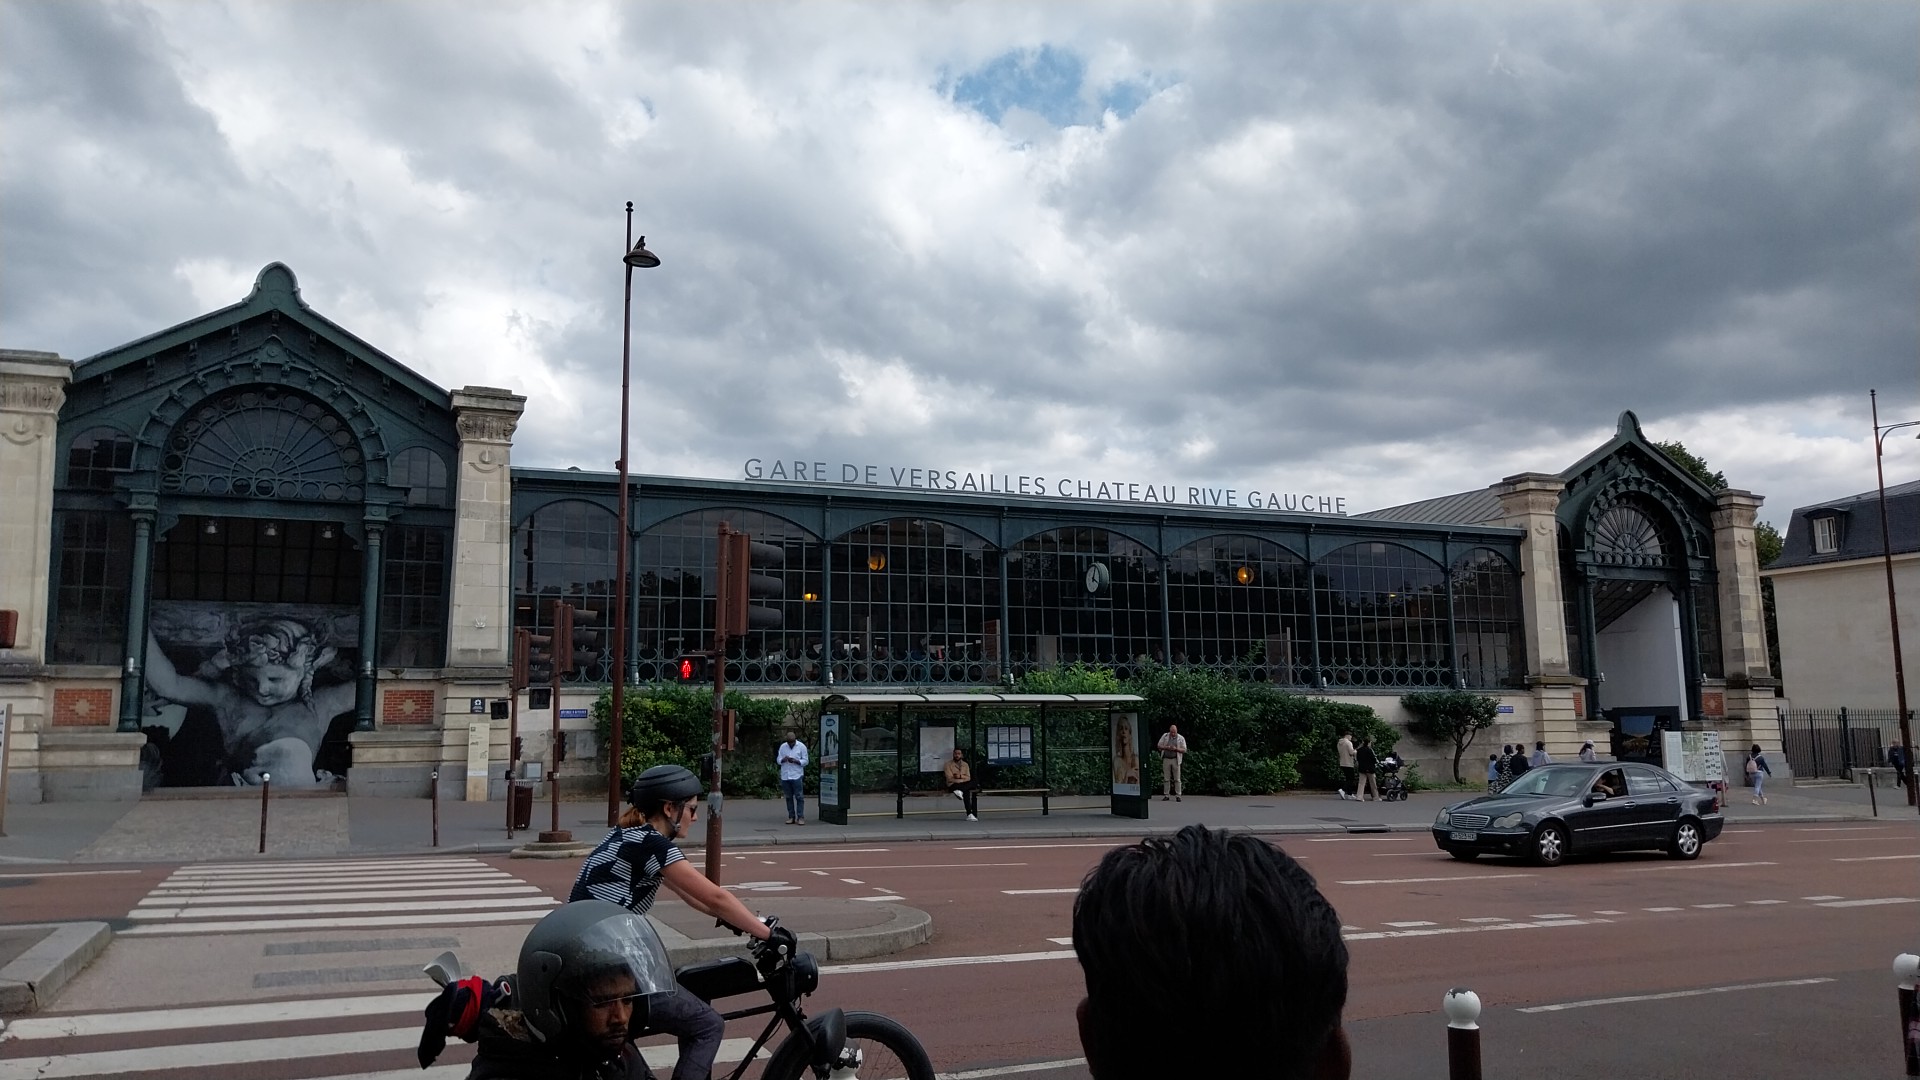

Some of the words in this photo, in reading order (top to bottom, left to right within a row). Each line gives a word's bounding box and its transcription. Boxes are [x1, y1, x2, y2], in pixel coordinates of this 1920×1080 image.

[744, 458, 827, 481] GARE
[842, 463, 878, 484] DE
[889, 466, 1046, 495] VERSAILLES
[1057, 478, 1176, 502] CHATEAU
[1188, 486, 1237, 507] RIVE
[1247, 491, 1347, 514] GAUCHE
